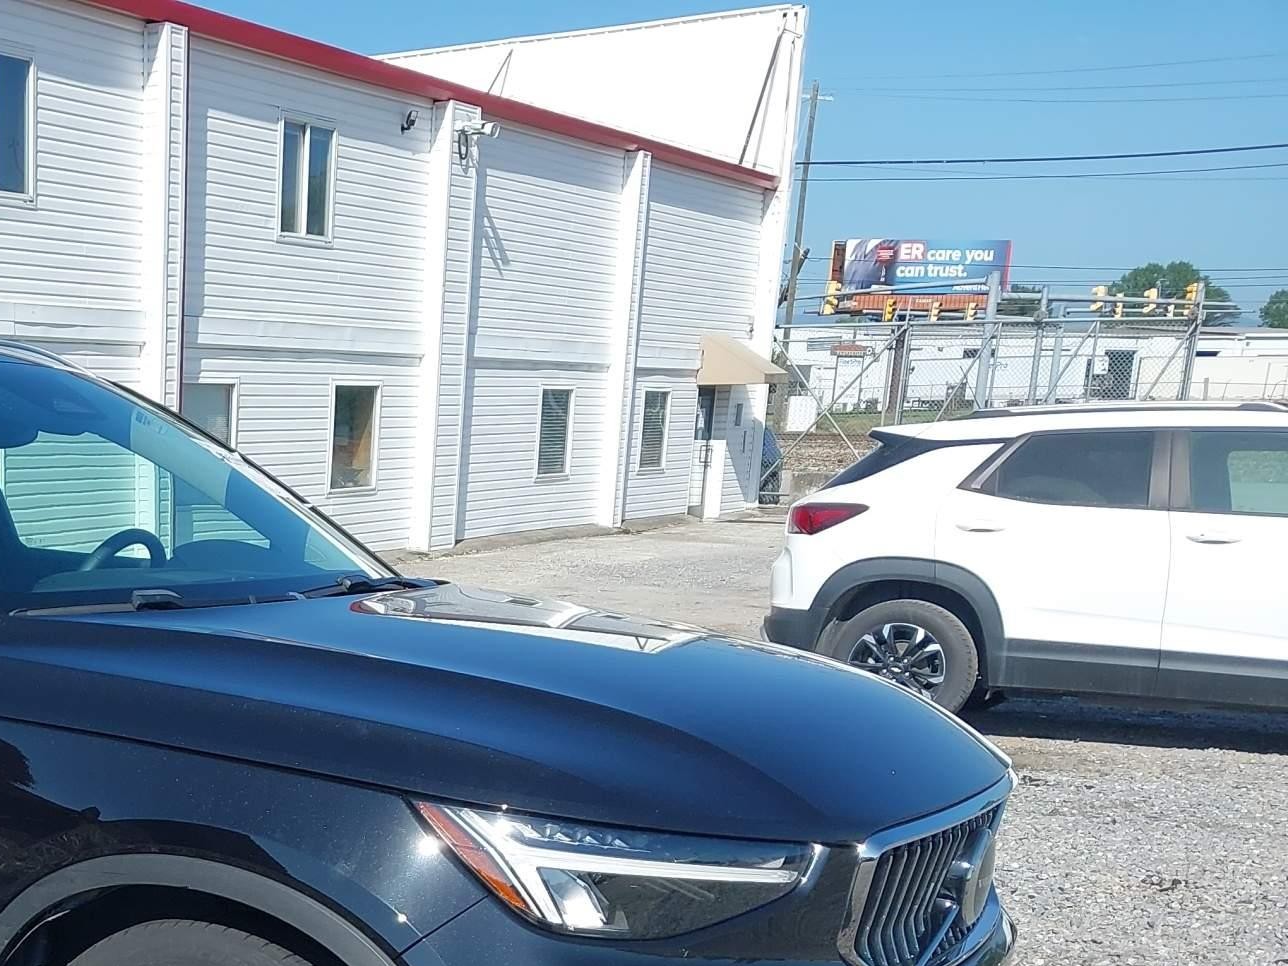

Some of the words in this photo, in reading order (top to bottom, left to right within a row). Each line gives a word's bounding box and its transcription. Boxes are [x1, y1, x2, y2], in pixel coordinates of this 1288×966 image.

[900, 243, 924, 260] ER
[927, 249, 962, 261] care
[965, 249, 994, 264] you
[896, 266, 925, 277] can
[927, 264, 968, 277] trust.
